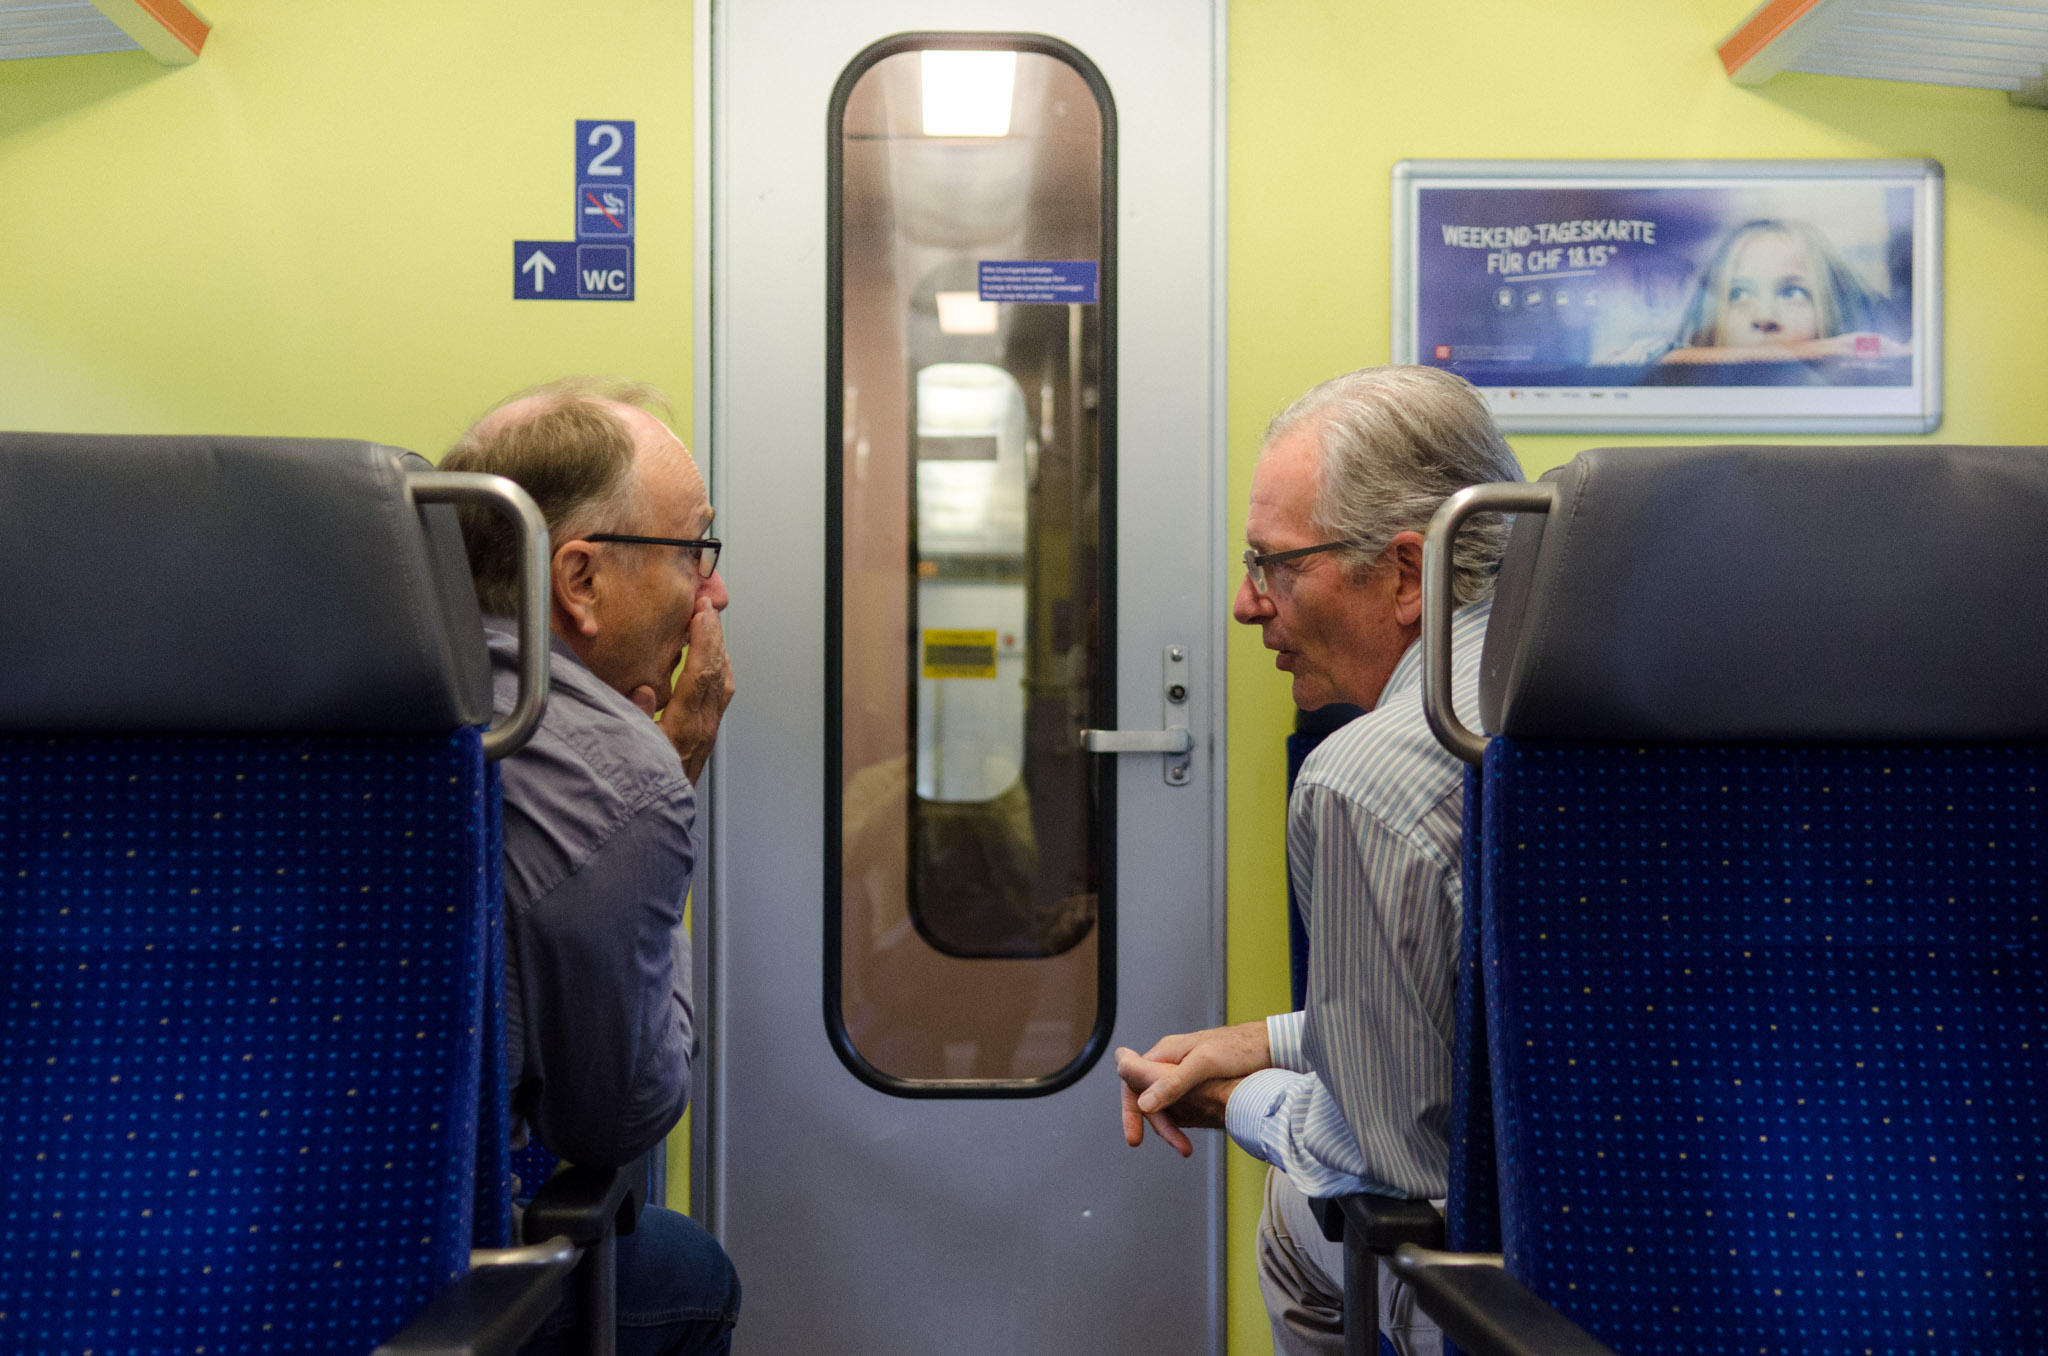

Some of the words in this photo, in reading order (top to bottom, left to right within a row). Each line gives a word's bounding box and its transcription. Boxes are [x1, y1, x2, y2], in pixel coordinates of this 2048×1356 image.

[587, 124, 624, 176] 2
[1442, 219, 1657, 249] WEEKEND-TAGESKARTE
[1487, 249, 1525, 275] FÜR
[1527, 247, 1564, 273] CHF
[582, 269, 625, 292] WC
